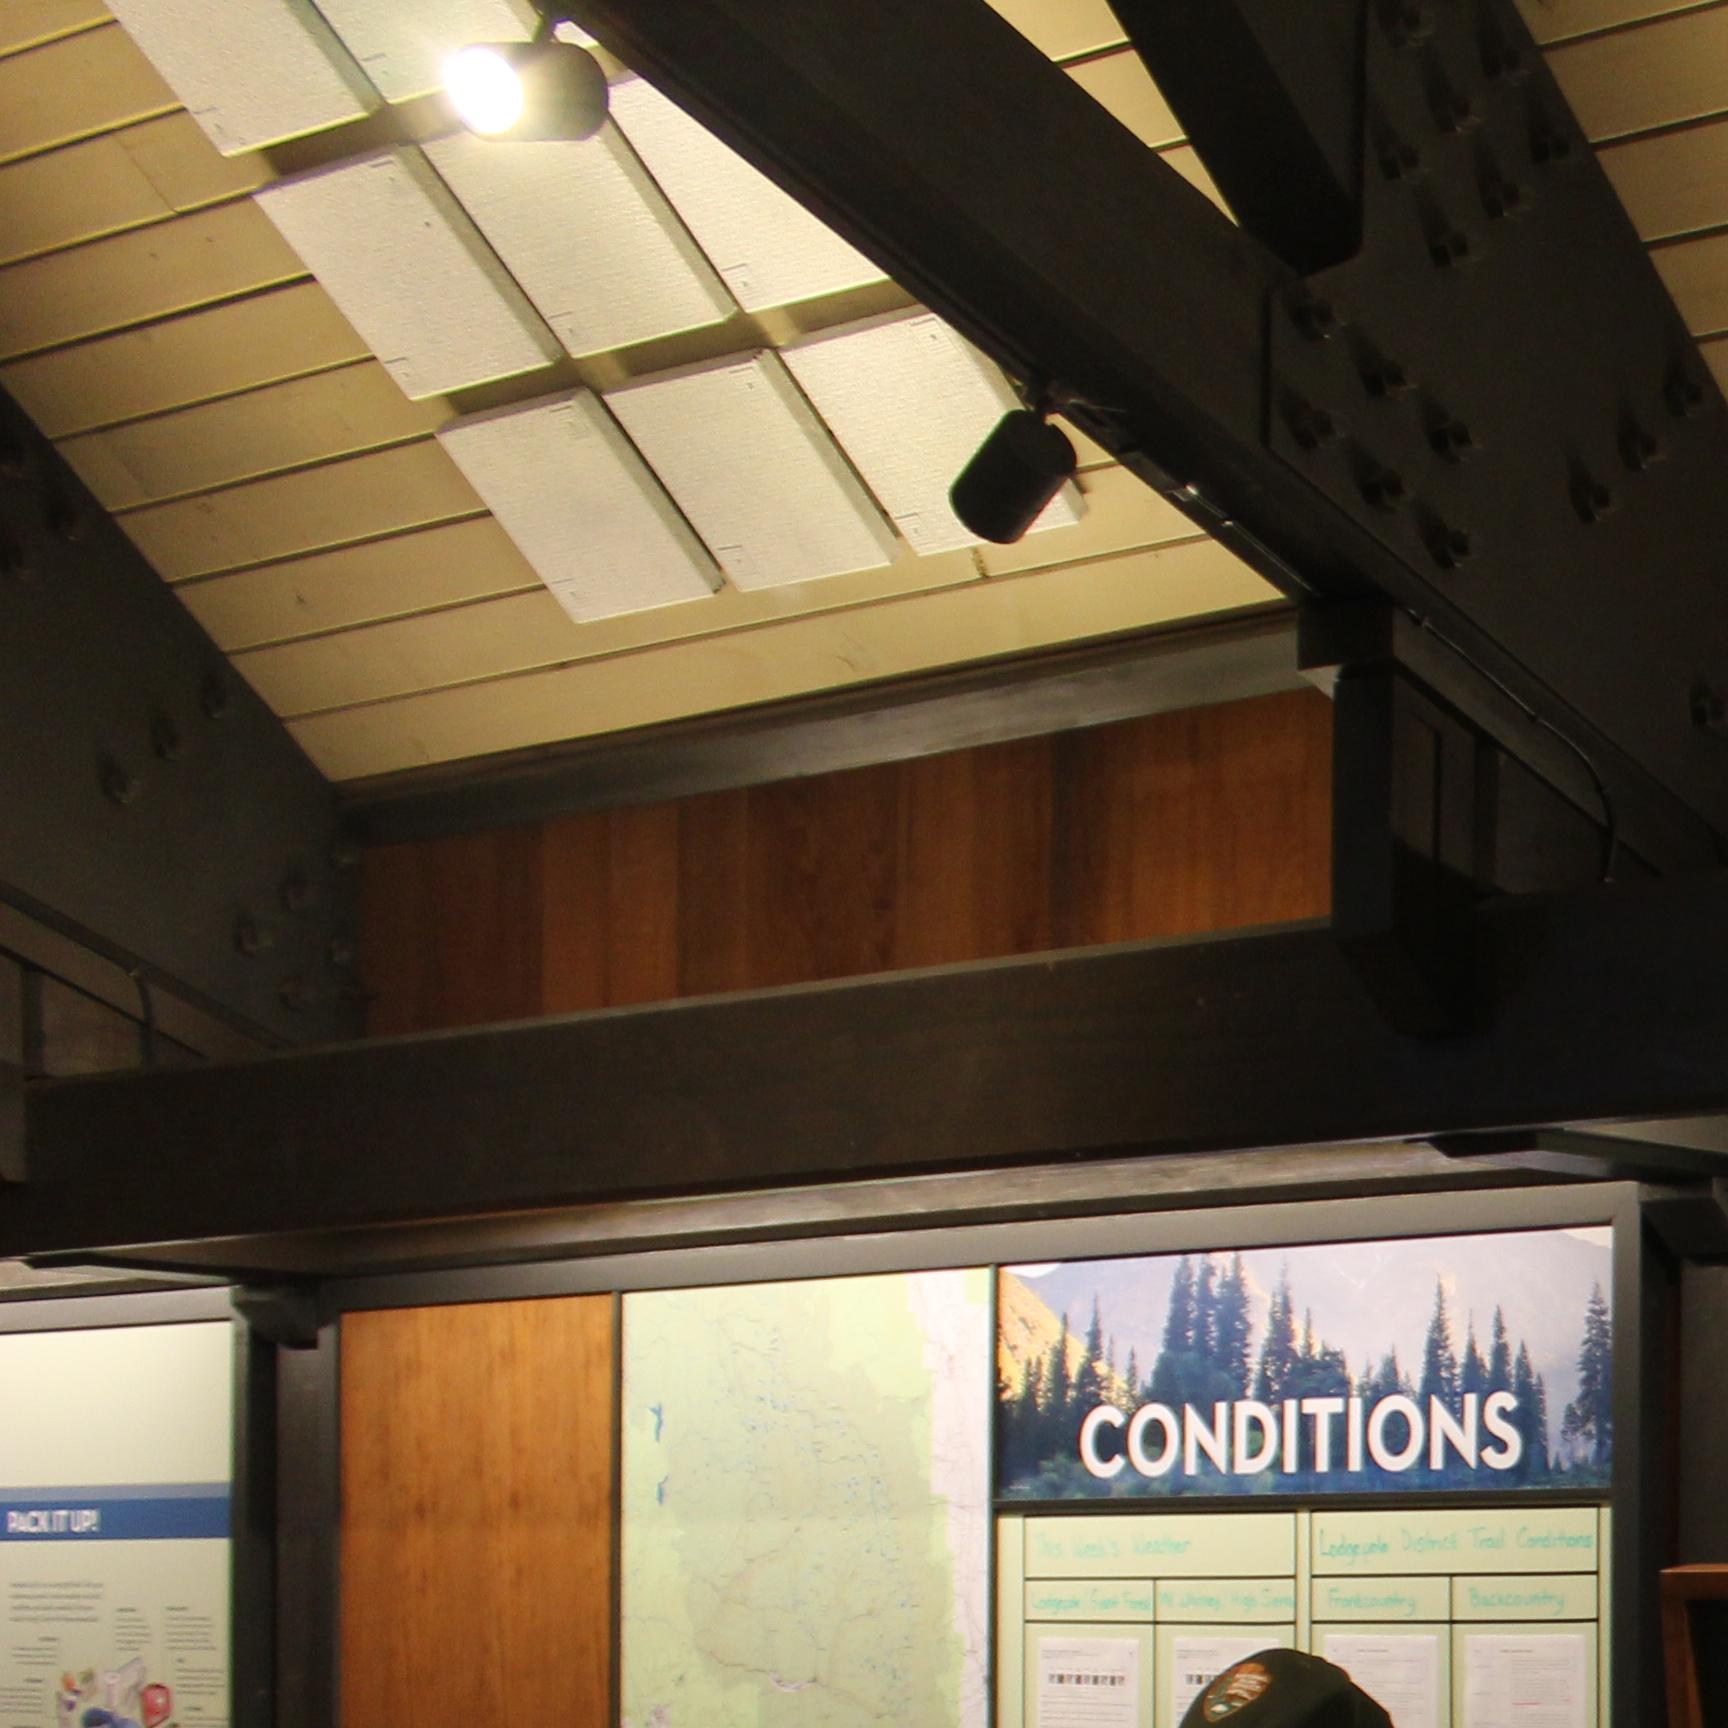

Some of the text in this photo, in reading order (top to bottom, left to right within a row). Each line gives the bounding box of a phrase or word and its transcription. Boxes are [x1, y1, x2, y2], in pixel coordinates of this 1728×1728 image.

[1080, 1391, 1523, 1478] CONDITIONS
[7, 1509, 100, 1533] PACK IT UP!
[1516, 1526, 1593, 1549] Conditions
